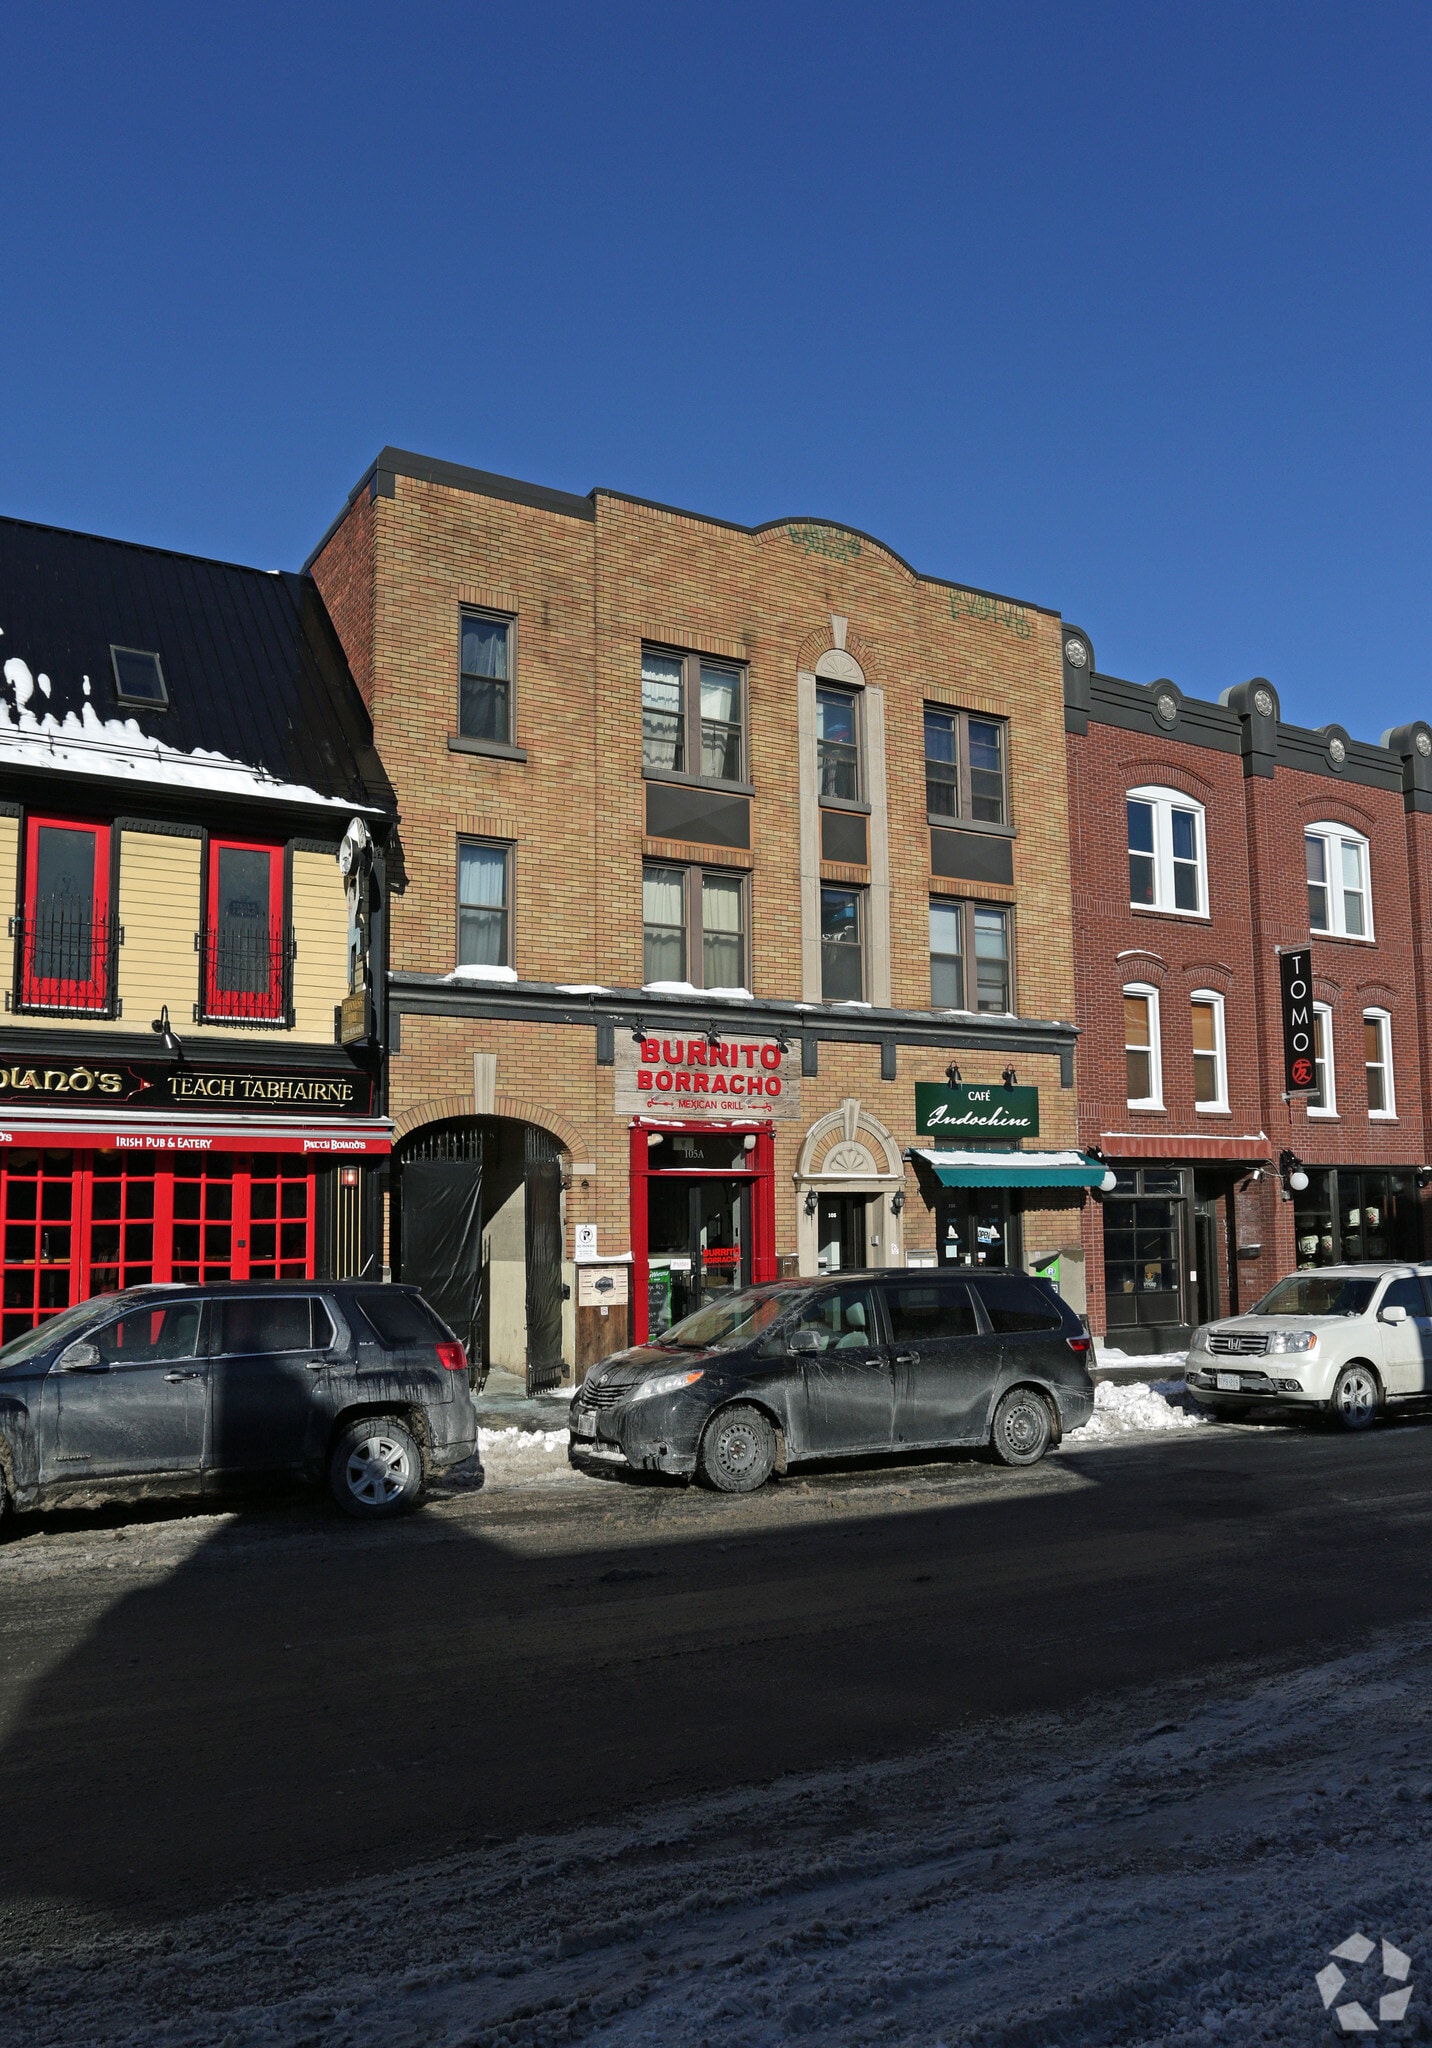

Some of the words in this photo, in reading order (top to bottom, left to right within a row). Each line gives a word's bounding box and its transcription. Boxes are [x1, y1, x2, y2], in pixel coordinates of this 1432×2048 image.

[1290, 955, 1309, 1052] TOMO
[641, 1038, 782, 1070] BURRITO
[167, 1077, 235, 1097] TEACH
[240, 1080, 354, 1100] TABHAIRNE
[637, 1070, 782, 1097] BORRACHO
[678, 1099, 718, 1110] MEXICAN
[721, 1101, 744, 1110] GRILL
[967, 1089, 991, 1102] CAFÉ
[926, 1104, 1031, 1127] Indochine
[116, 1136, 143, 1147] IRISH
[146, 1136, 166, 1148] PUB
[167, 1137, 175, 1148] &
[177, 1138, 213, 1149] EATERY
[685, 1149, 704, 1159] 105A
[703, 1247, 741, 1257] BURRITO
